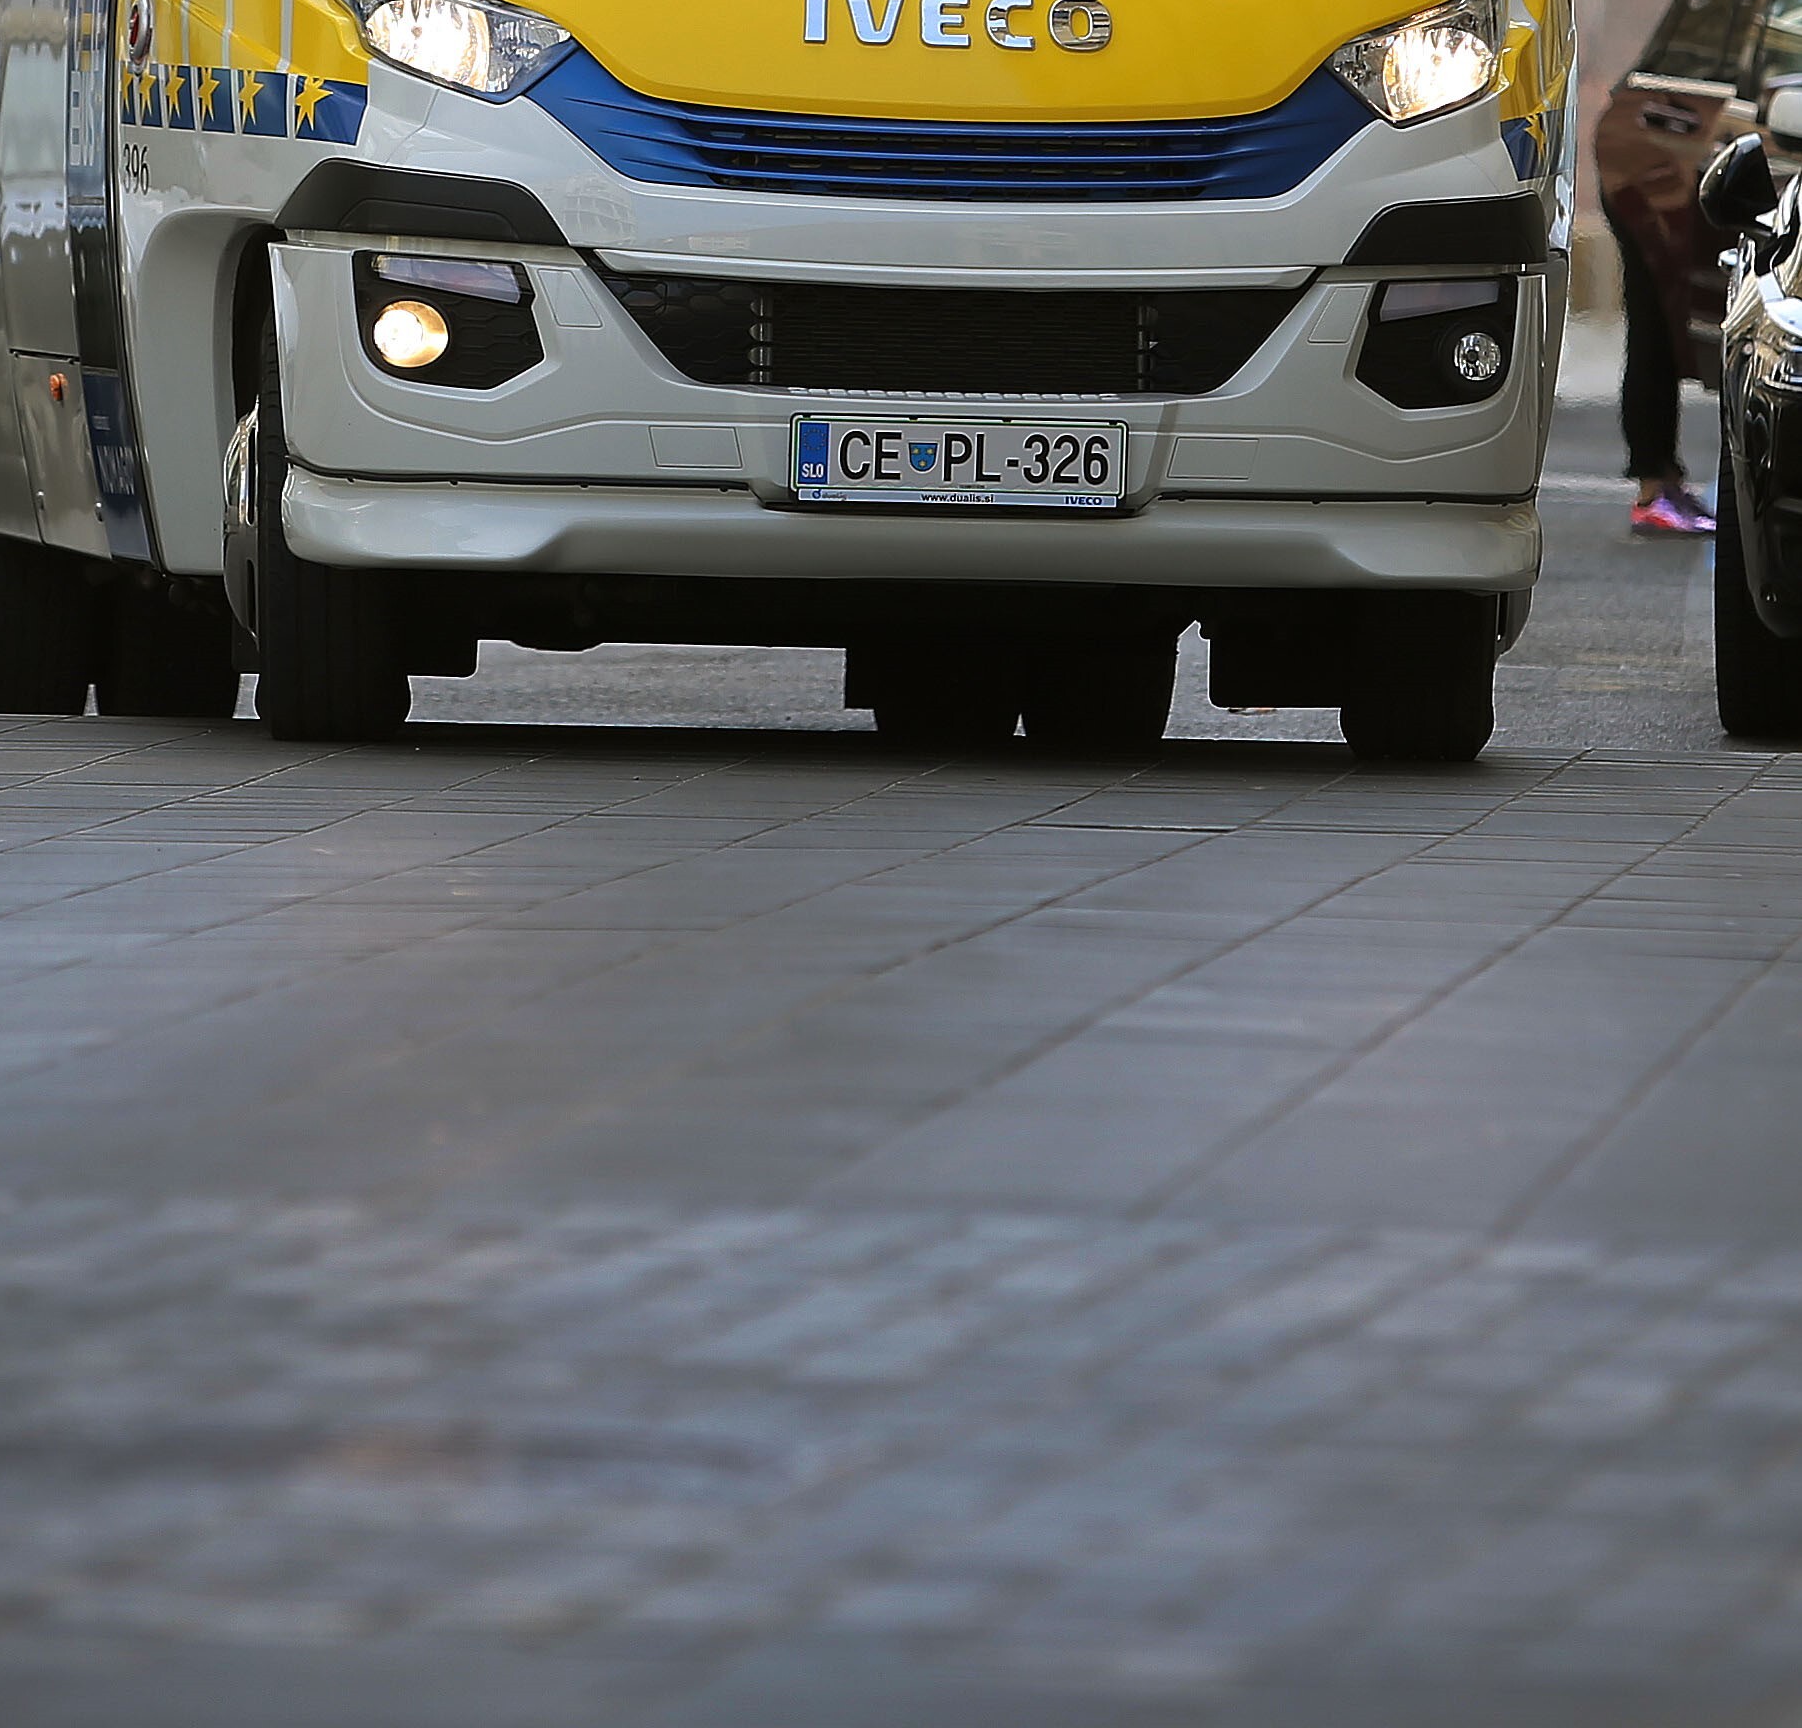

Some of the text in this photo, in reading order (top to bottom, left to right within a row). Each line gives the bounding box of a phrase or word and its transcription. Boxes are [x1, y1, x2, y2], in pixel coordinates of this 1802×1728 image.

[122, 143, 149, 195] 396
[839, 430, 1109, 485] CE PL-326
[801, 462, 825, 479] SLO
[920, 491, 994, 504] www.dualis.si
[1065, 495, 1103, 506] IVECO
